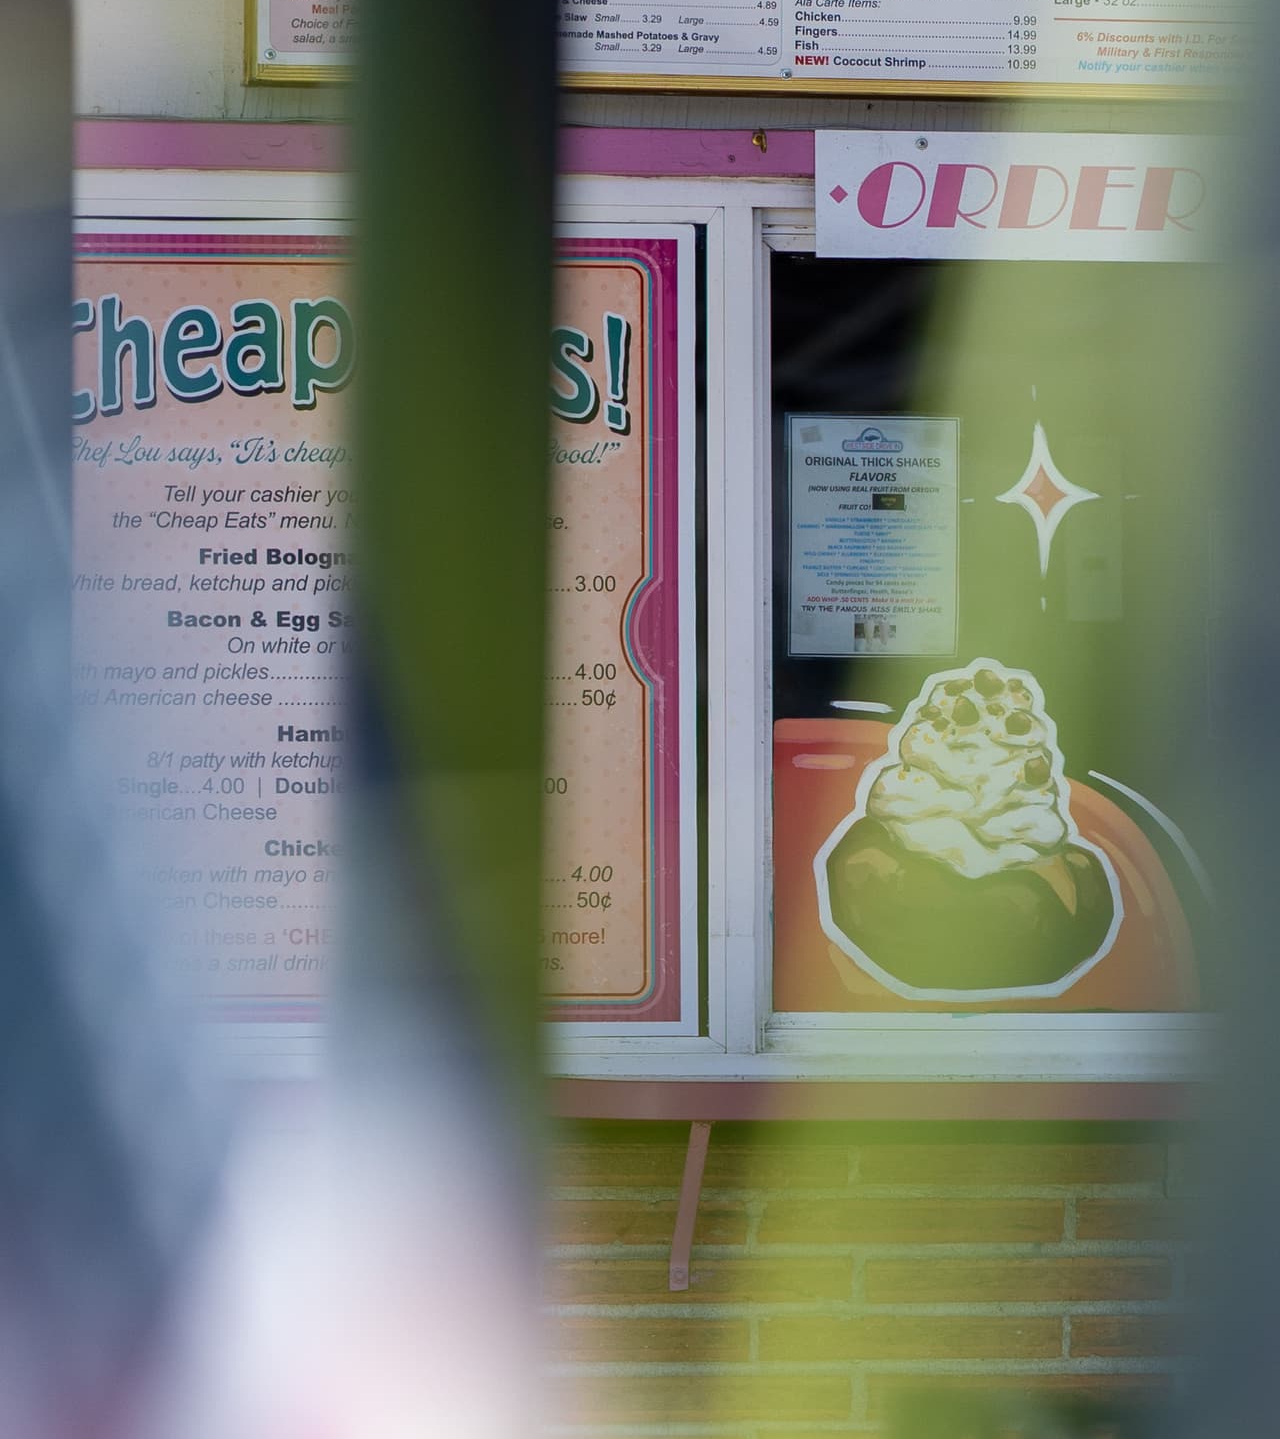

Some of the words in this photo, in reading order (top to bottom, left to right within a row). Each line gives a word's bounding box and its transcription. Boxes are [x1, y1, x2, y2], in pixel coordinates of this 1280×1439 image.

[857, 161, 1206, 231] ORDER
[114, 435, 161, 465] Lou
[168, 447, 222, 469] says,
[165, 485, 196, 502] Tell
[201, 490, 246, 506] your
[250, 486, 321, 503] cashier
[113, 511, 142, 528] the
[279, 515, 337, 530] menu.
[200, 548, 257, 565] Fried
[575, 575, 616, 592] 3.00
[168, 611, 241, 627] Bacon
[250, 611, 267, 627] &
[277, 611, 319, 632] Egg
[575, 663, 616, 680] 4.00
